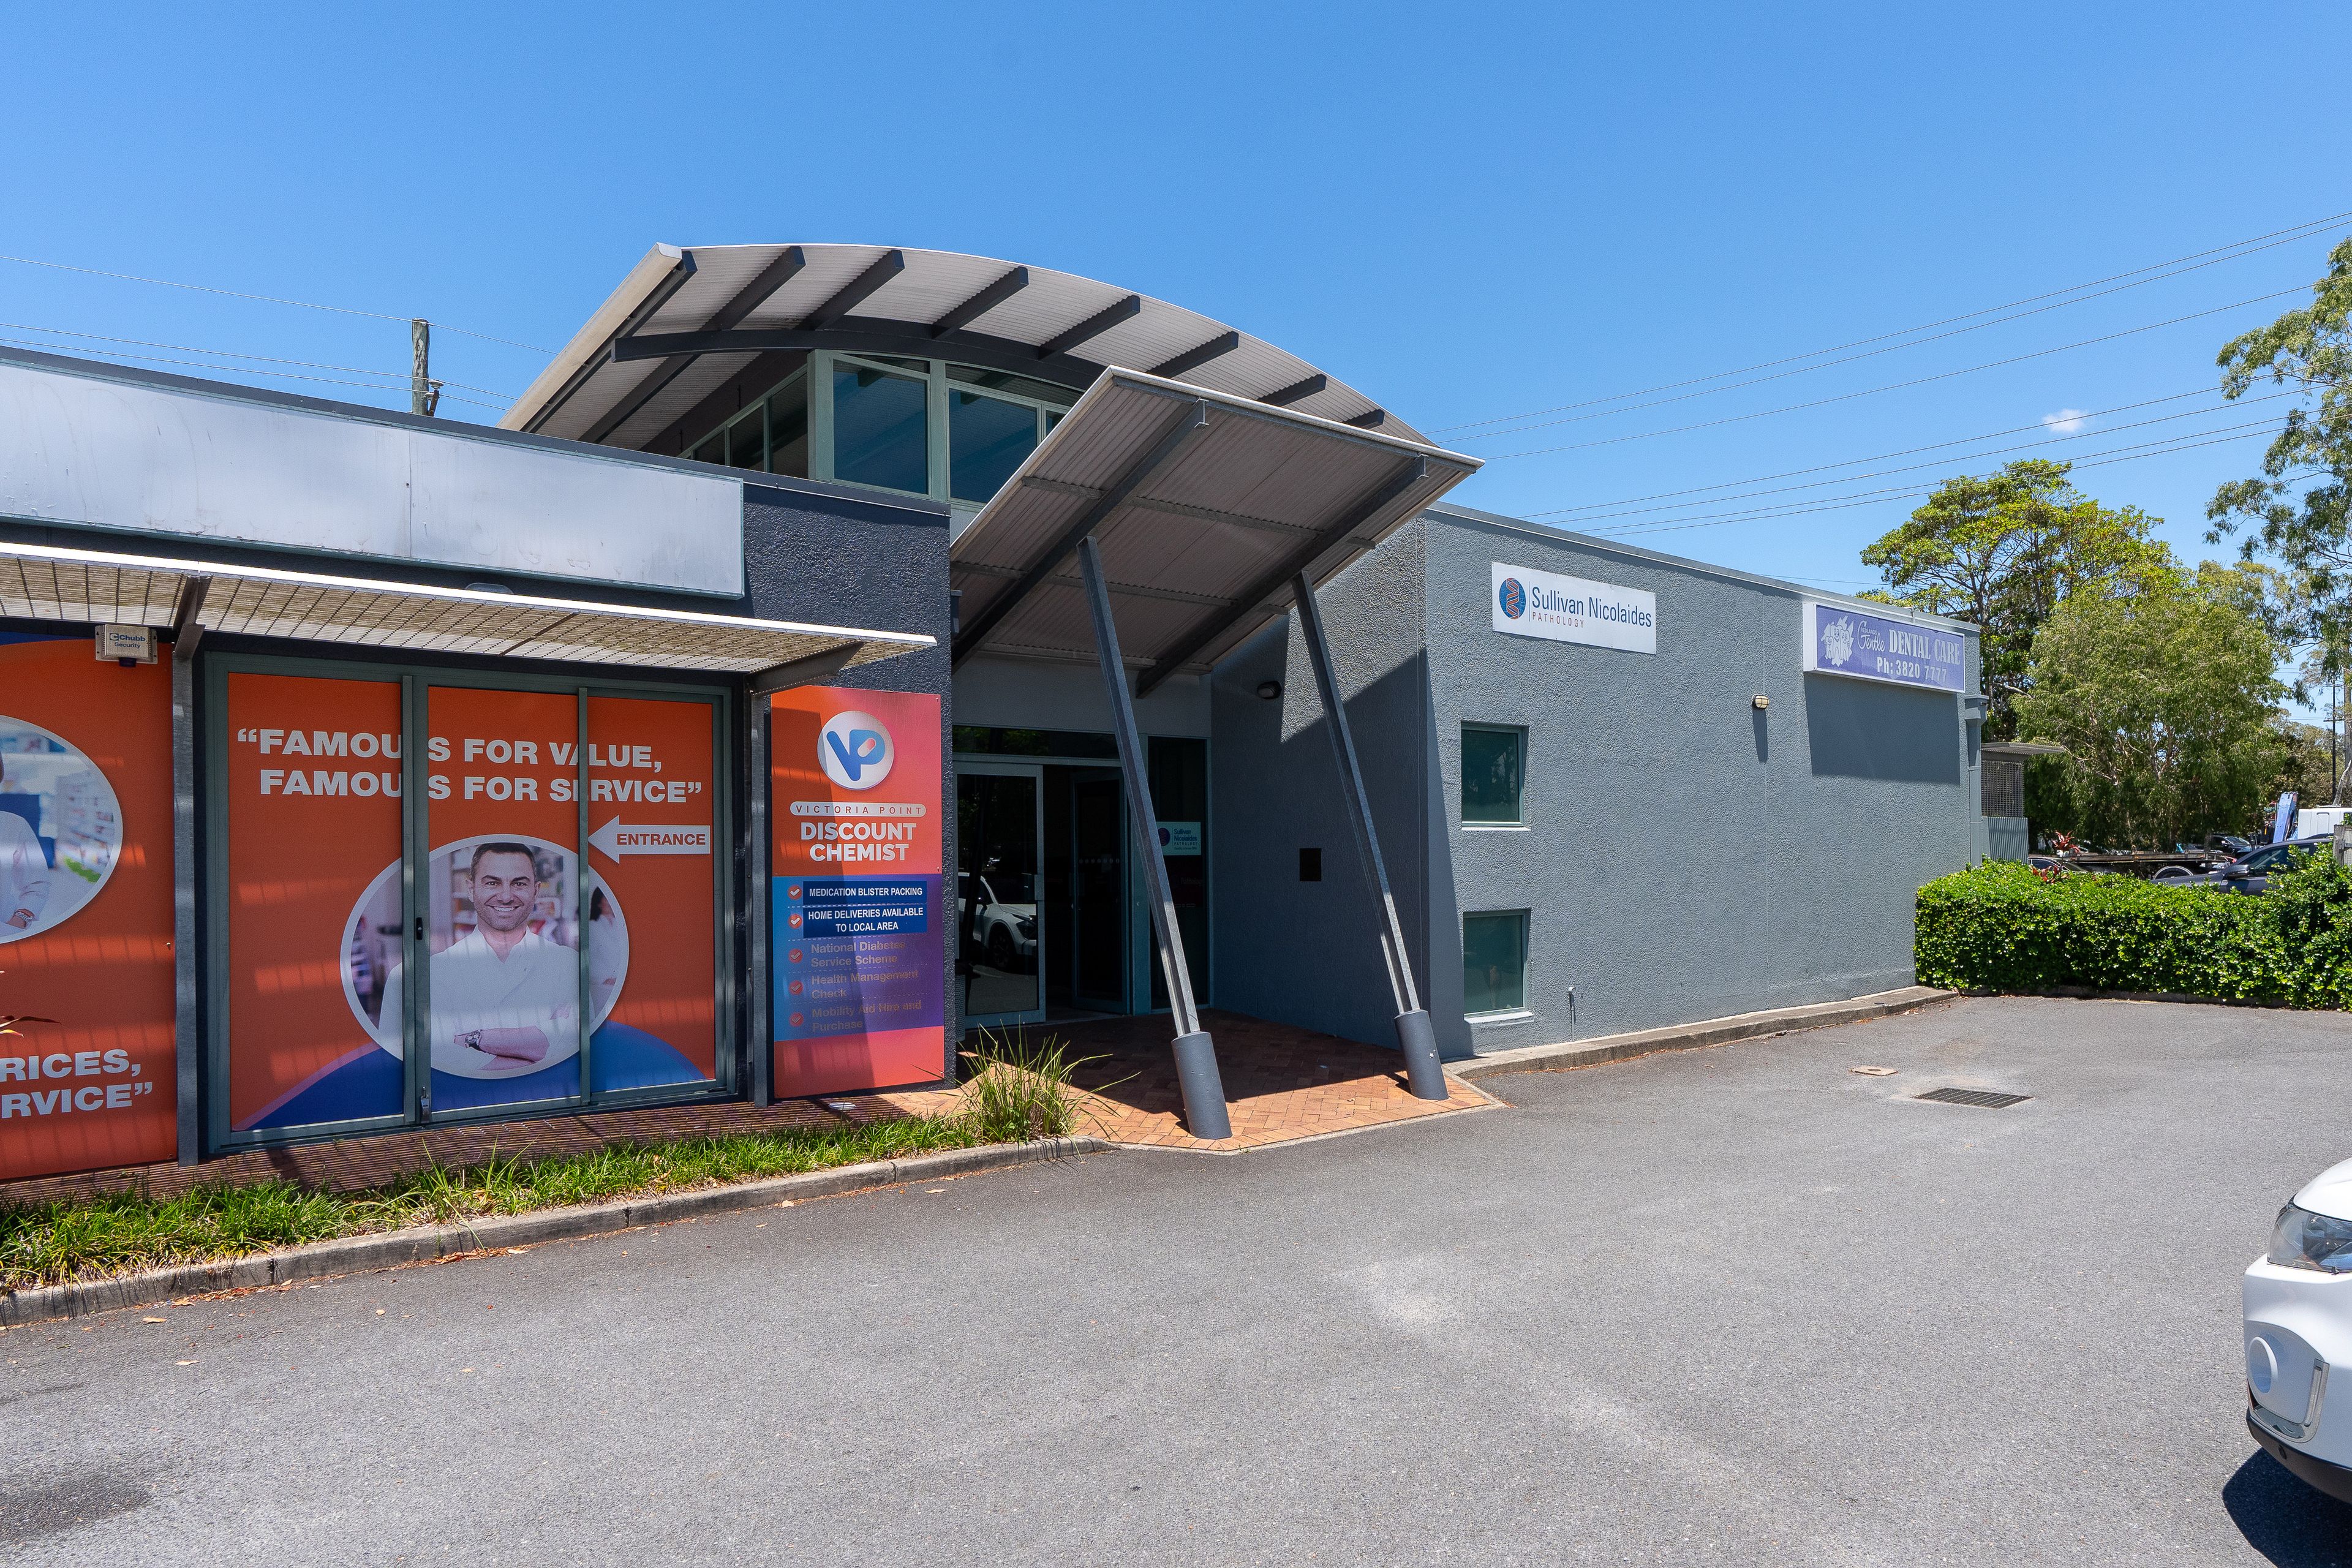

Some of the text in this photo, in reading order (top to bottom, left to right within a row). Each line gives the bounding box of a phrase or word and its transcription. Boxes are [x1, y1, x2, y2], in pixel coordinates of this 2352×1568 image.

[1532, 586, 1652, 628] Sullivan Nicolaides
[1532, 611, 1585, 628] PATHOLOGY
[1858, 620, 1960, 665] Gentle DENTAL CARE
[1877, 656, 1947, 682] Ph: 3820 7777
[464, 739, 538, 764] FOR
[826, 729, 886, 781] VP
[260, 769, 451, 800] FAMOUS
[464, 777, 538, 801] FOR
[795, 805, 869, 814] VICTORIA
[801, 822, 917, 840] DISCOUNT
[616, 833, 706, 846] ENTRANCE
[809, 843, 910, 862] CHEMIST
[809, 887, 922, 897] MEDICATION BLISTER PACKING
[808, 907, 924, 920] HOME DELIVERIES AVAILABLE
[835, 921, 899, 932] TO LOCAL AREA
[811, 941, 906, 954] National Diabetes
[811, 954, 898, 968] Service Scheme
[812, 970, 919, 986] Health Management
[811, 989, 847, 1000] Check
[812, 1006, 856, 1018] Mobility
[812, 1021, 863, 1033] Purchase
